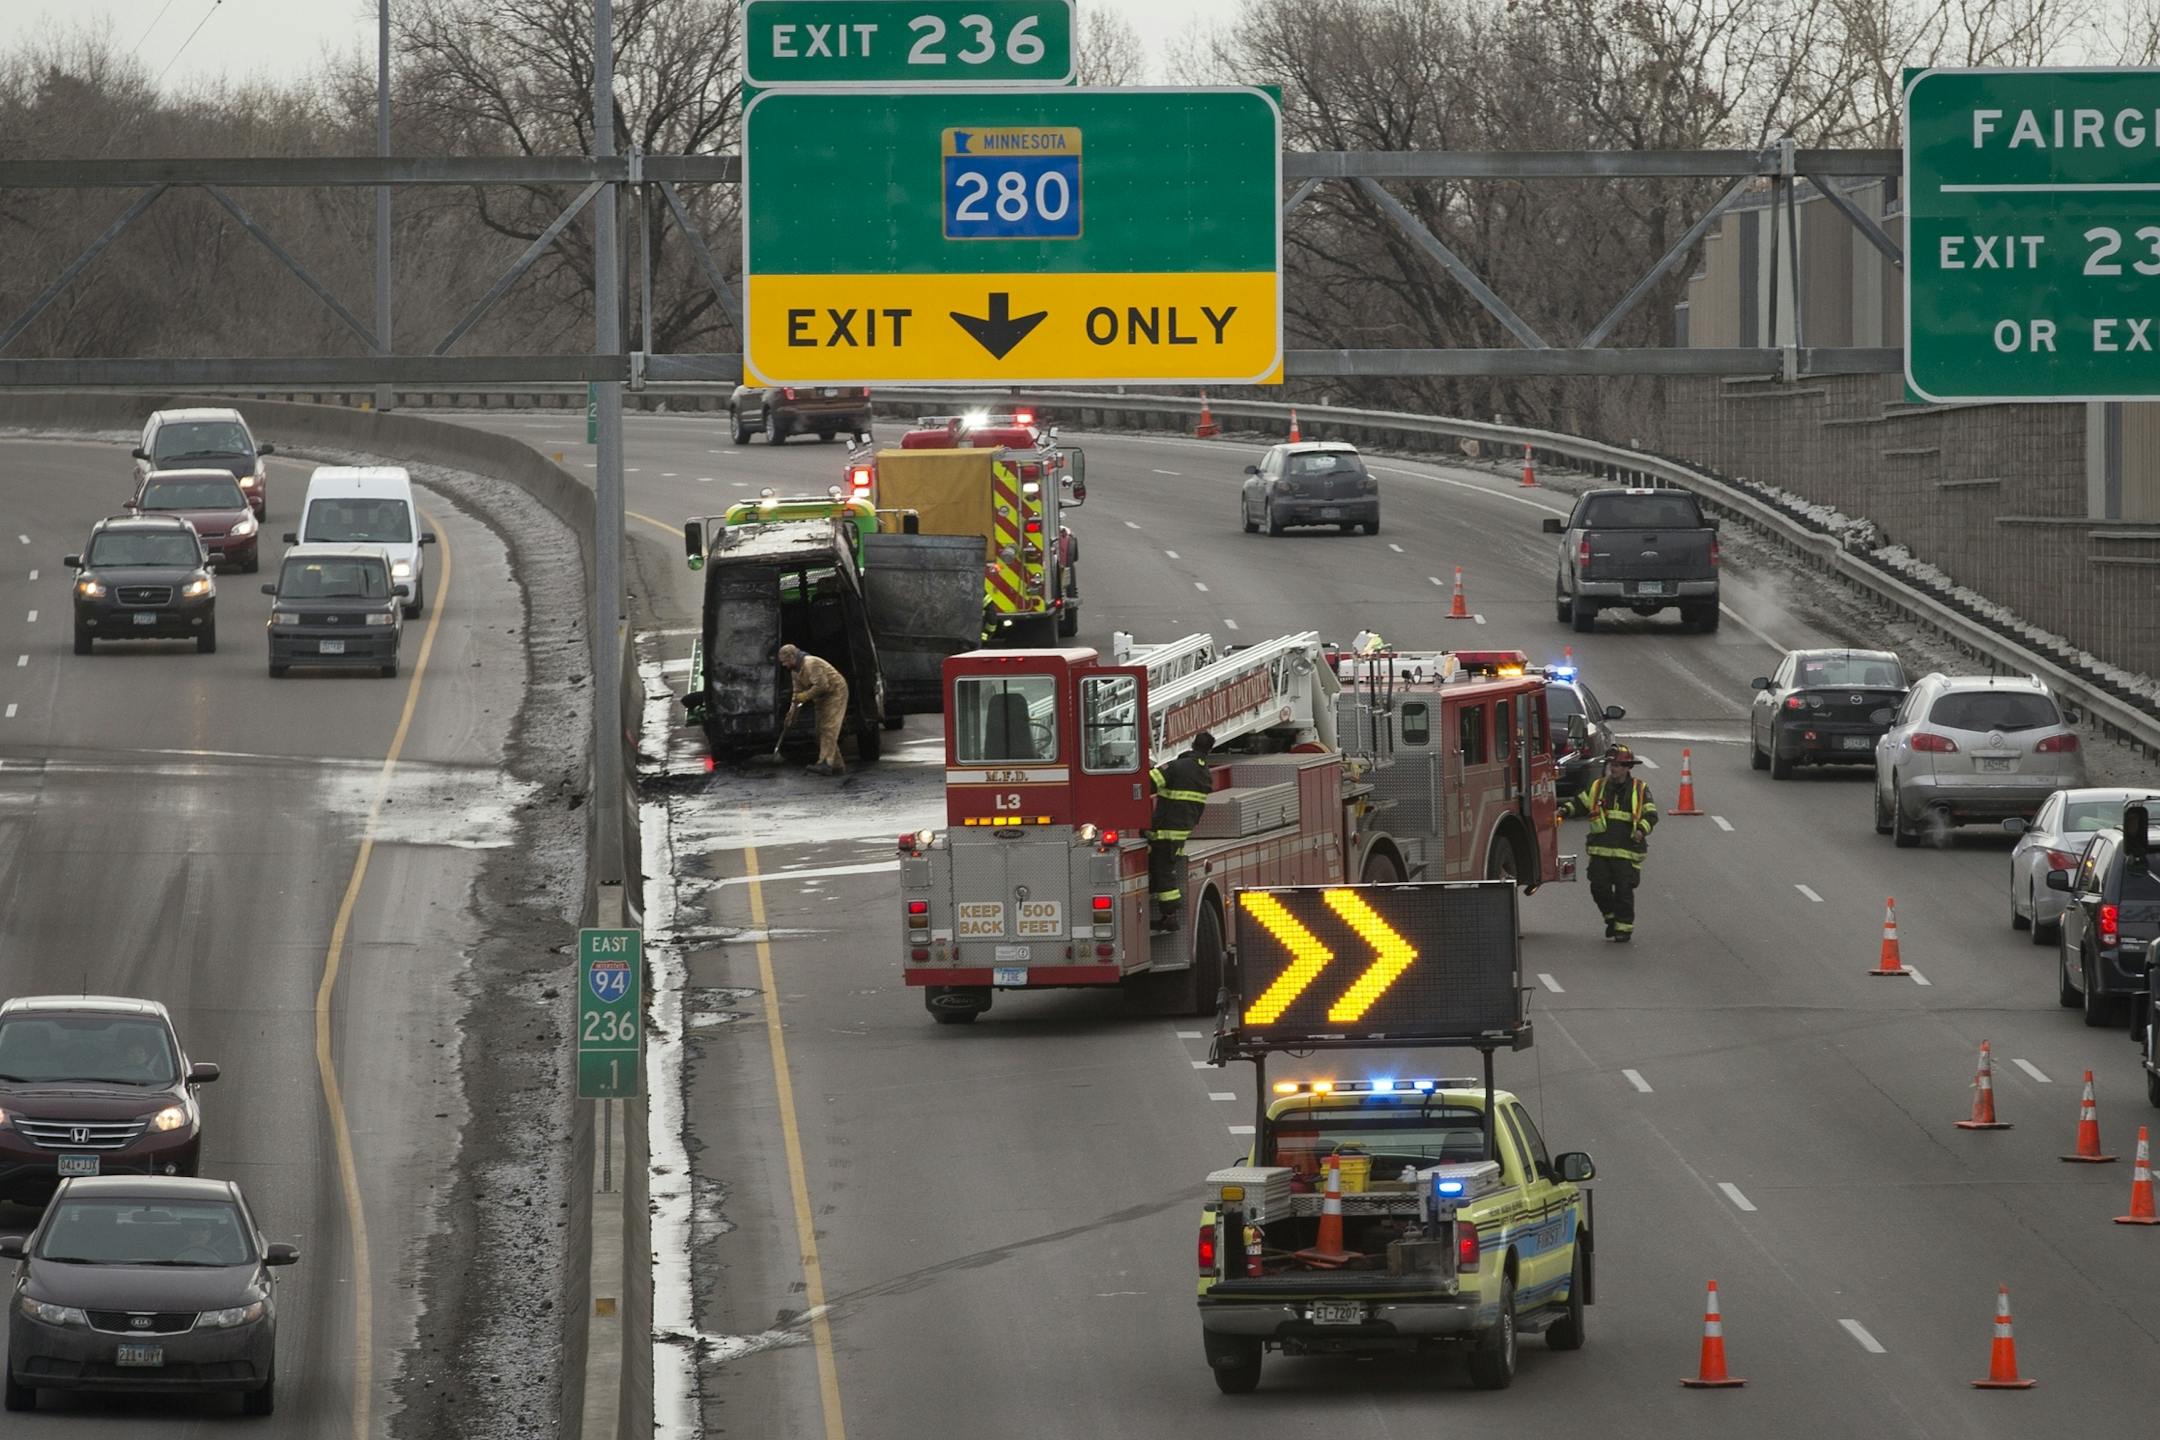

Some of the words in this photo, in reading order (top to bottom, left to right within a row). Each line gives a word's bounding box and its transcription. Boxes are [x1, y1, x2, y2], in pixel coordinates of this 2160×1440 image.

[772, 24, 878, 58] EXIT
[907, 15, 1046, 65] 236
[1973, 108, 2160, 148] FAIRG
[984, 133, 1066, 150] MINNESOTA
[956, 171, 1069, 222] 280
[1940, 236, 2045, 269] EXIT
[787, 308, 912, 347] EXIT
[1085, 306, 1238, 345] ONLY
[1994, 319, 2057, 352] OR
[2093, 319, 2160, 352] EX
[1168, 696, 1212, 743] MINNEAPOLIS
[1213, 690, 1227, 723] FIRE
[1228, 670, 1268, 716] DEPARTMENT
[985, 771, 1029, 782] M.F.D.
[995, 793, 1021, 810] L3
[960, 904, 1001, 918] KEEP
[1023, 904, 1055, 917] 500
[960, 921, 1003, 934] BACK
[1019, 920, 1059, 933] FEET
[592, 936, 629, 952] EAST
[596, 971, 625, 993] 94
[583, 1011, 636, 1041] 236
[1316, 1306, 1358, 1319] ET-7207
